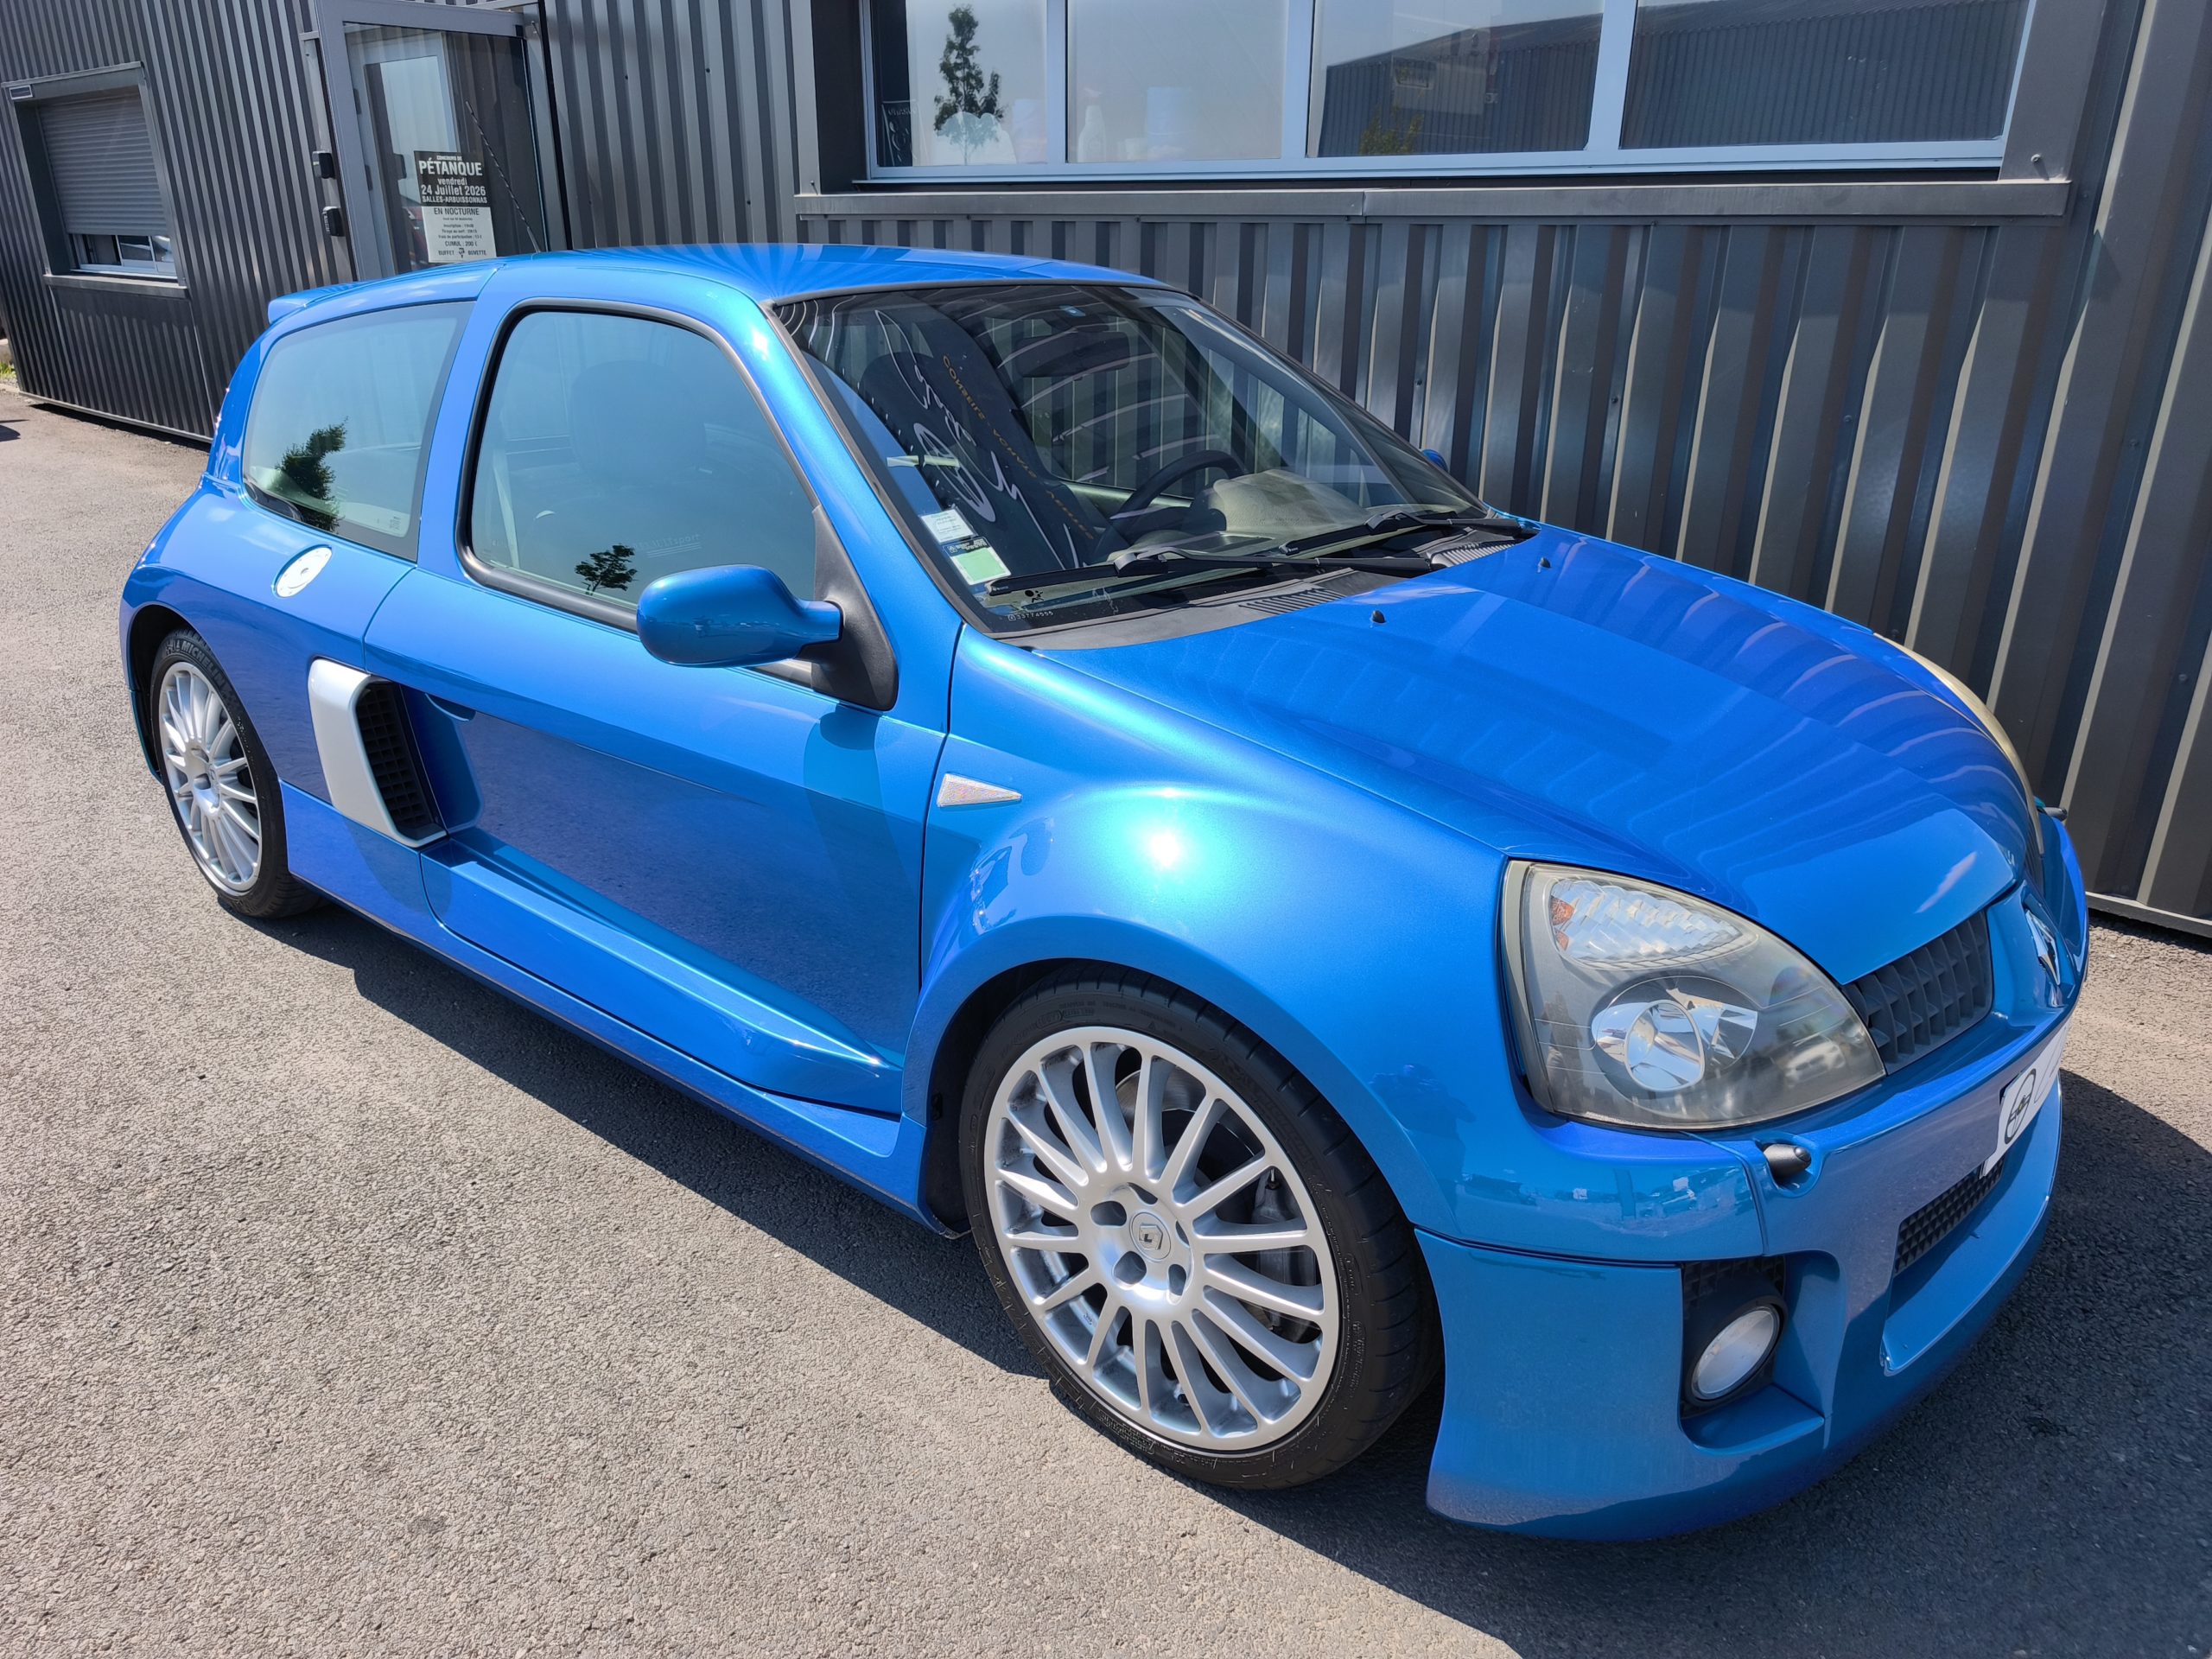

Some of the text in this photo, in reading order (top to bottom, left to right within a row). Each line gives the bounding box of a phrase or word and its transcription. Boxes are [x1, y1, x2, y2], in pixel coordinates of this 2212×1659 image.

[419, 157, 483, 176] PÉTANQUE
[421, 185, 486, 196] 24 Juillet 2026
[422, 195, 487, 204] SALLES-ARBUISSONNAS
[445, 207, 480, 216] NOCTURNE
[181, 640, 225, 688] MICHELIN
